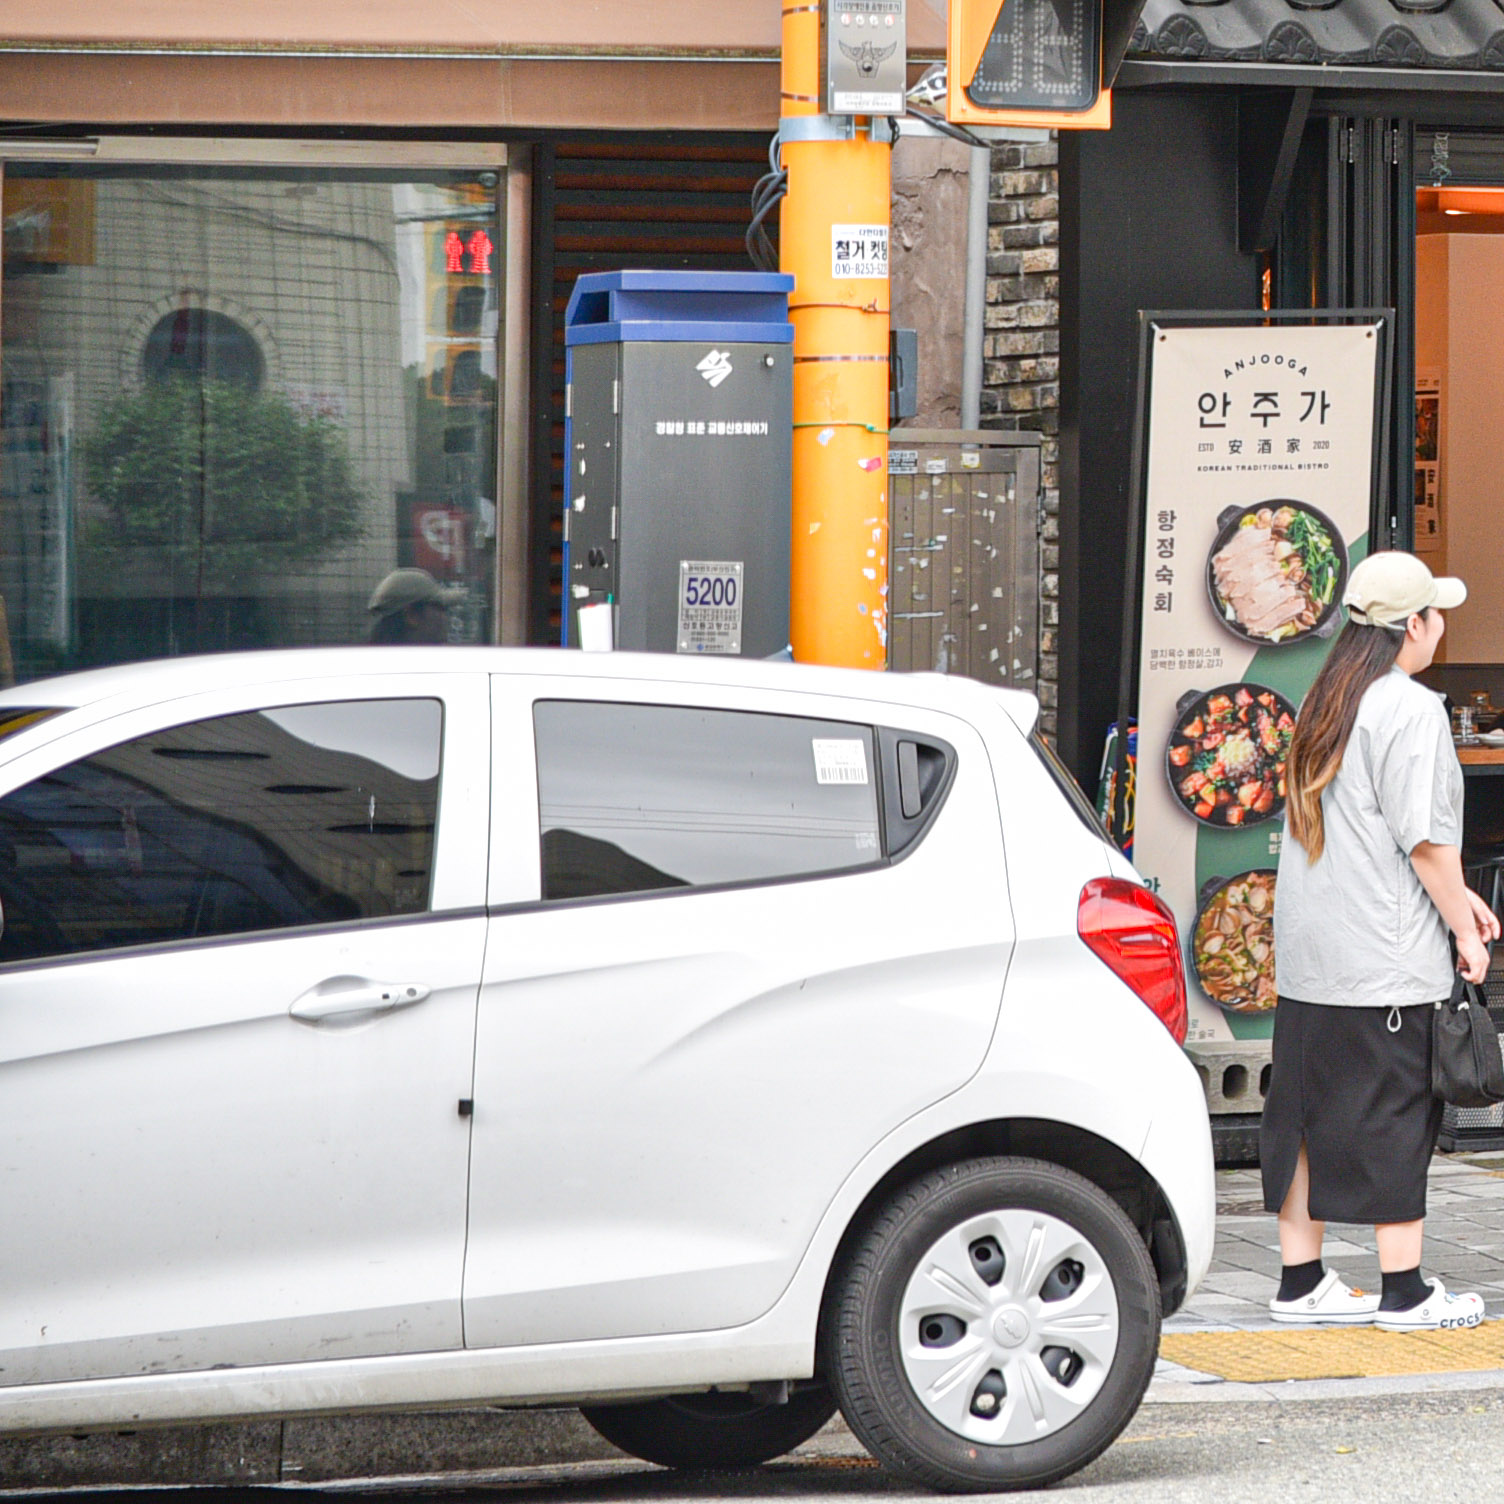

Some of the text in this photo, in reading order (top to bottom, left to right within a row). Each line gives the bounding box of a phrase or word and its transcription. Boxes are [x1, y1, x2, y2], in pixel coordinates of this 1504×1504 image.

[835, 240, 864, 260] 철거
[1223, 354, 1307, 379] ANJOOGA
[1198, 390, 1331, 428] 안주가
[1198, 443, 1214, 452] ESTD
[1313, 440, 1330, 450] 2020
[686, 577, 737, 606] 5200
